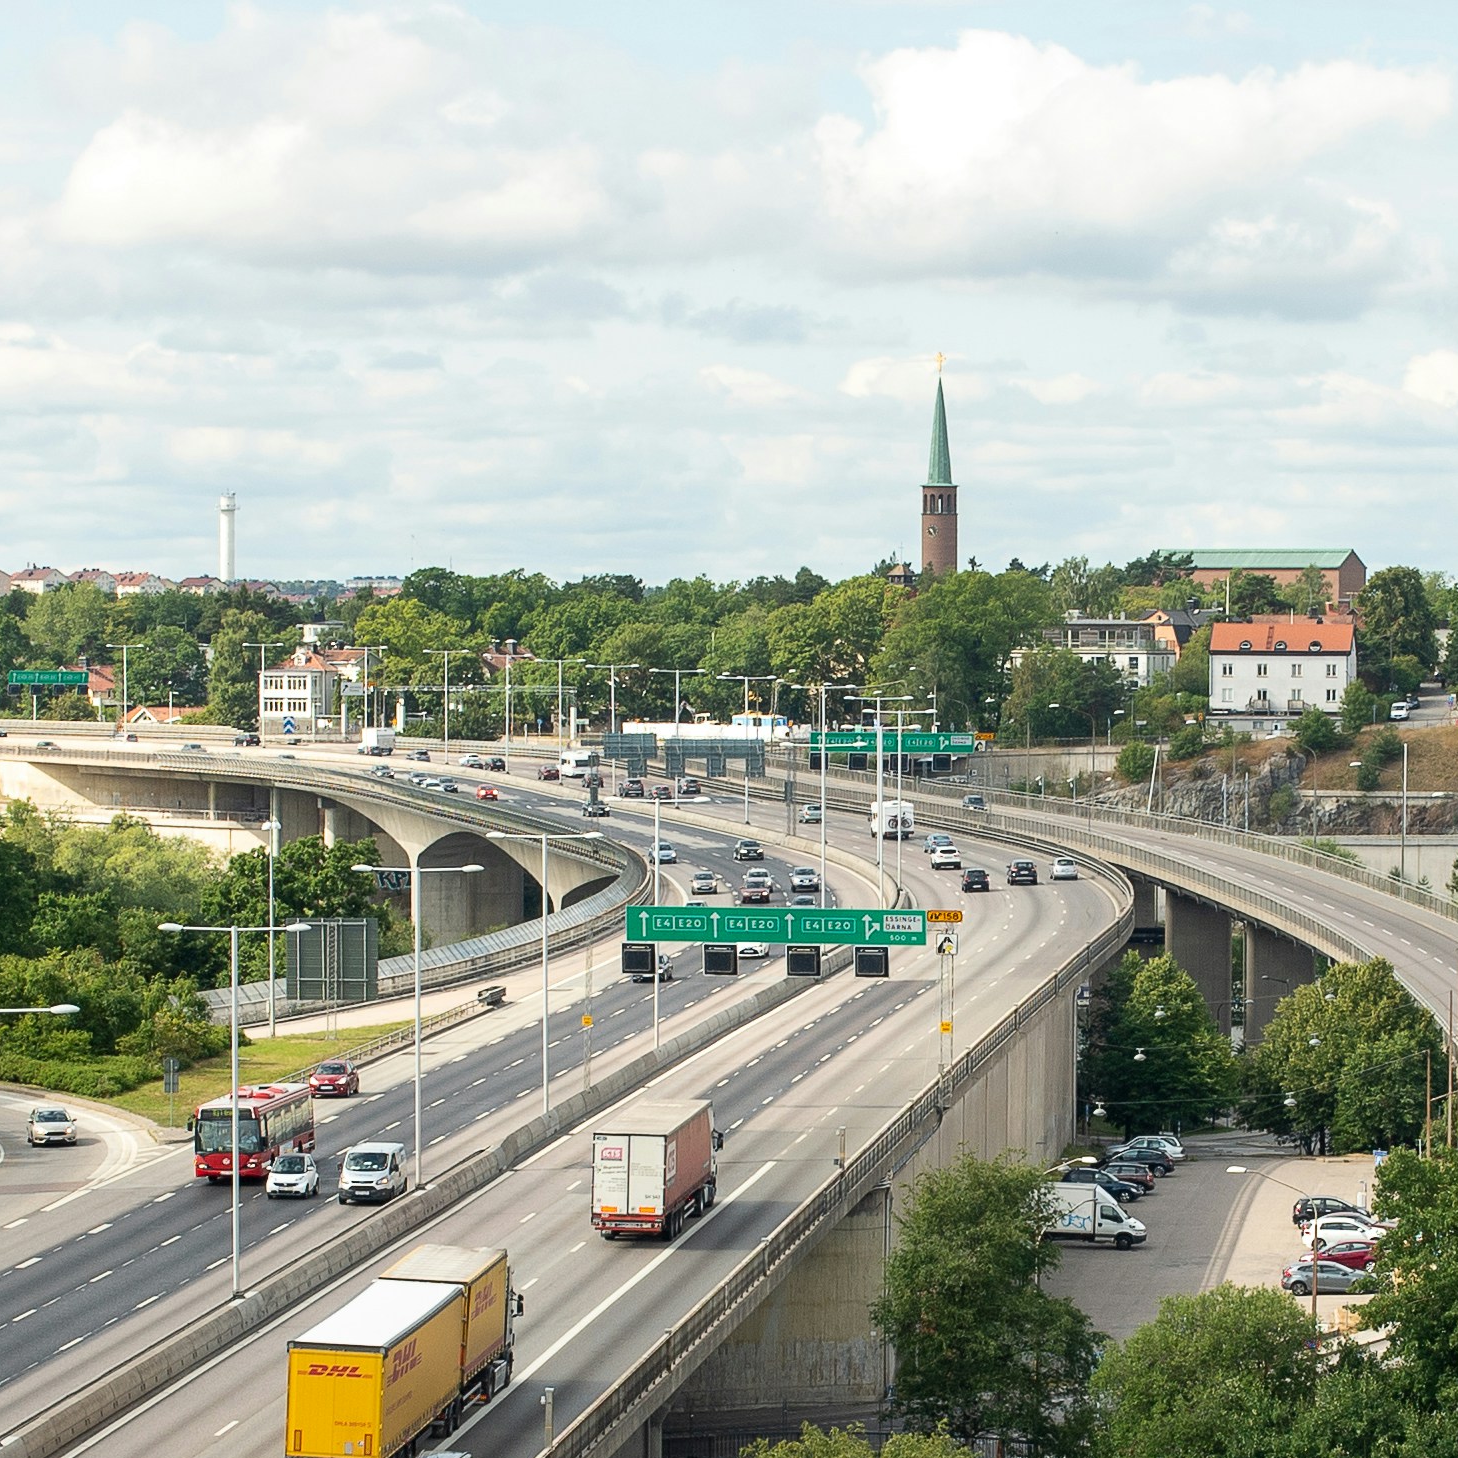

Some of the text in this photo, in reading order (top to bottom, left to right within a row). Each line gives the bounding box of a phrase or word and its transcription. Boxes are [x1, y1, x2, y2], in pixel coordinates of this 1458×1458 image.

[656, 918, 702, 929] E4 E20
[729, 919, 775, 929] E4 E20
[805, 920, 851, 931] E4 E20
[308, 1364, 363, 1378] DHL
